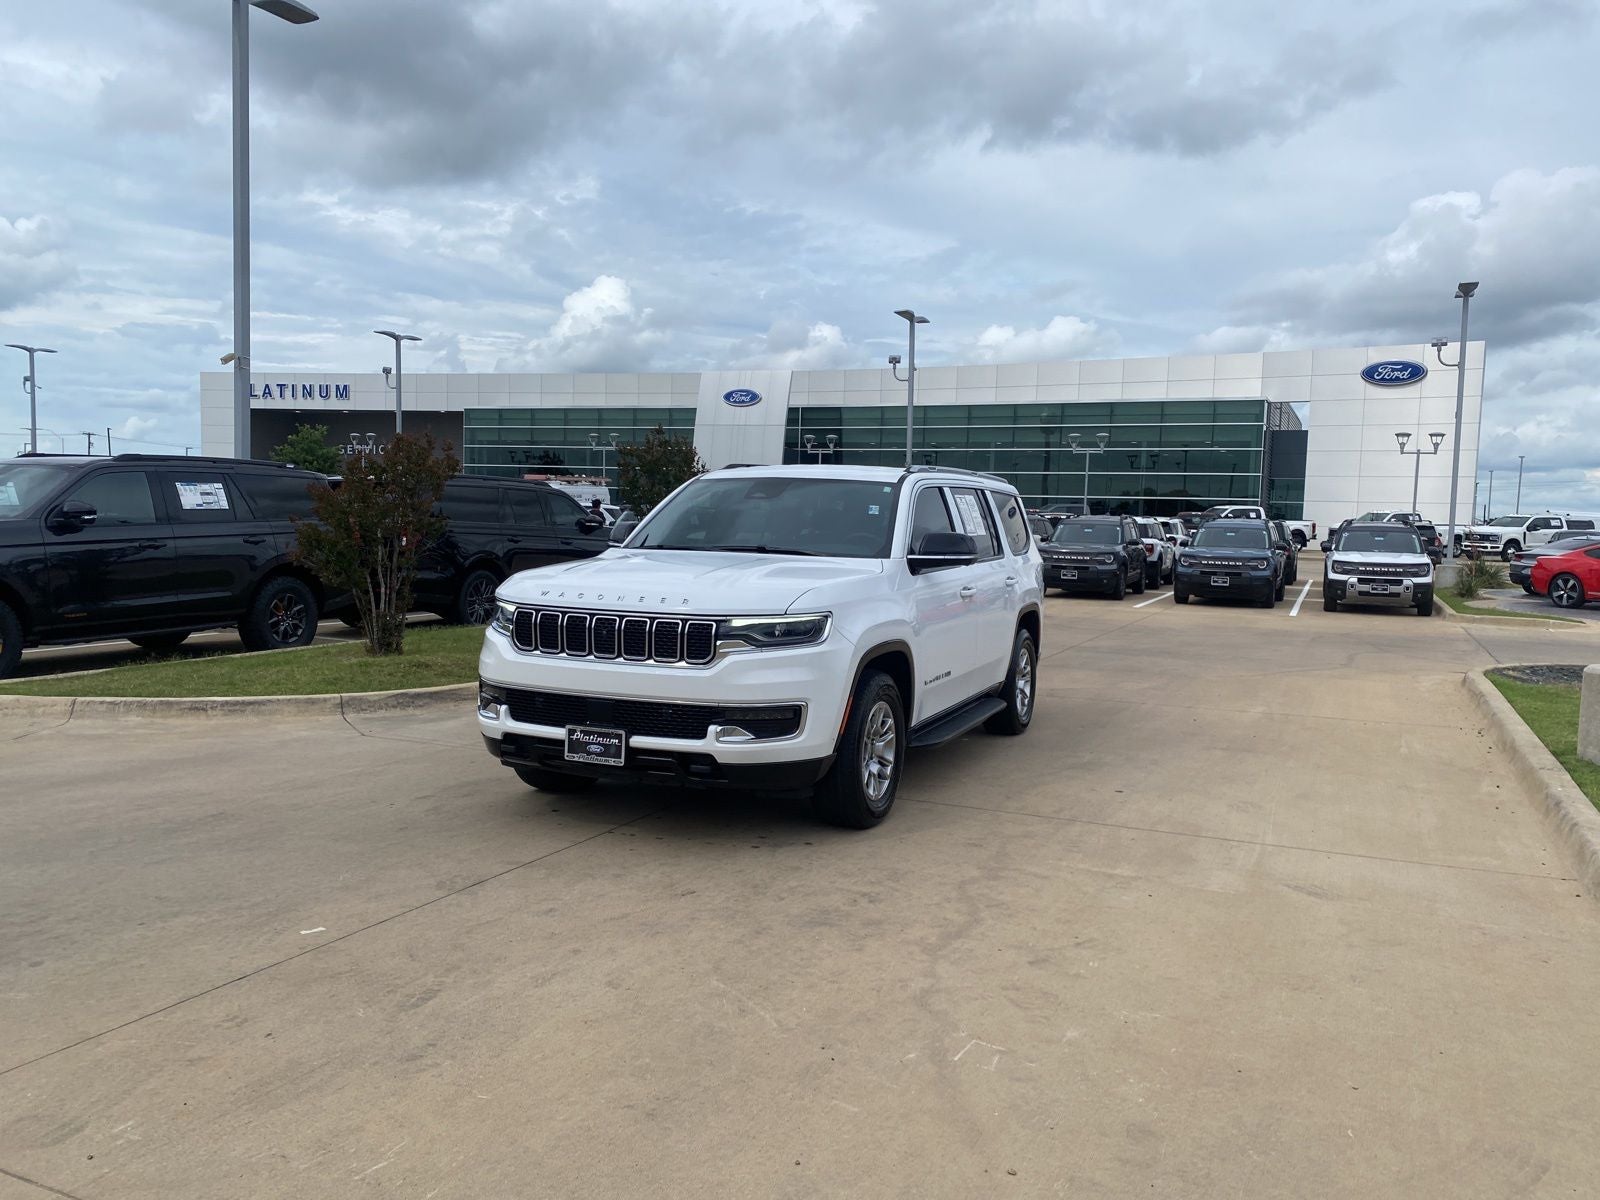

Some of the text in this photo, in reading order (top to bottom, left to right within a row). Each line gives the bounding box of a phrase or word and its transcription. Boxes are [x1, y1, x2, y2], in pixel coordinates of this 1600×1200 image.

[1373, 364, 1412, 380] Ford
[249, 383, 351, 400] LATINUM
[729, 391, 752, 402] Ford
[540, 590, 690, 606] WAGONEER
[570, 731, 622, 746] Platinum
